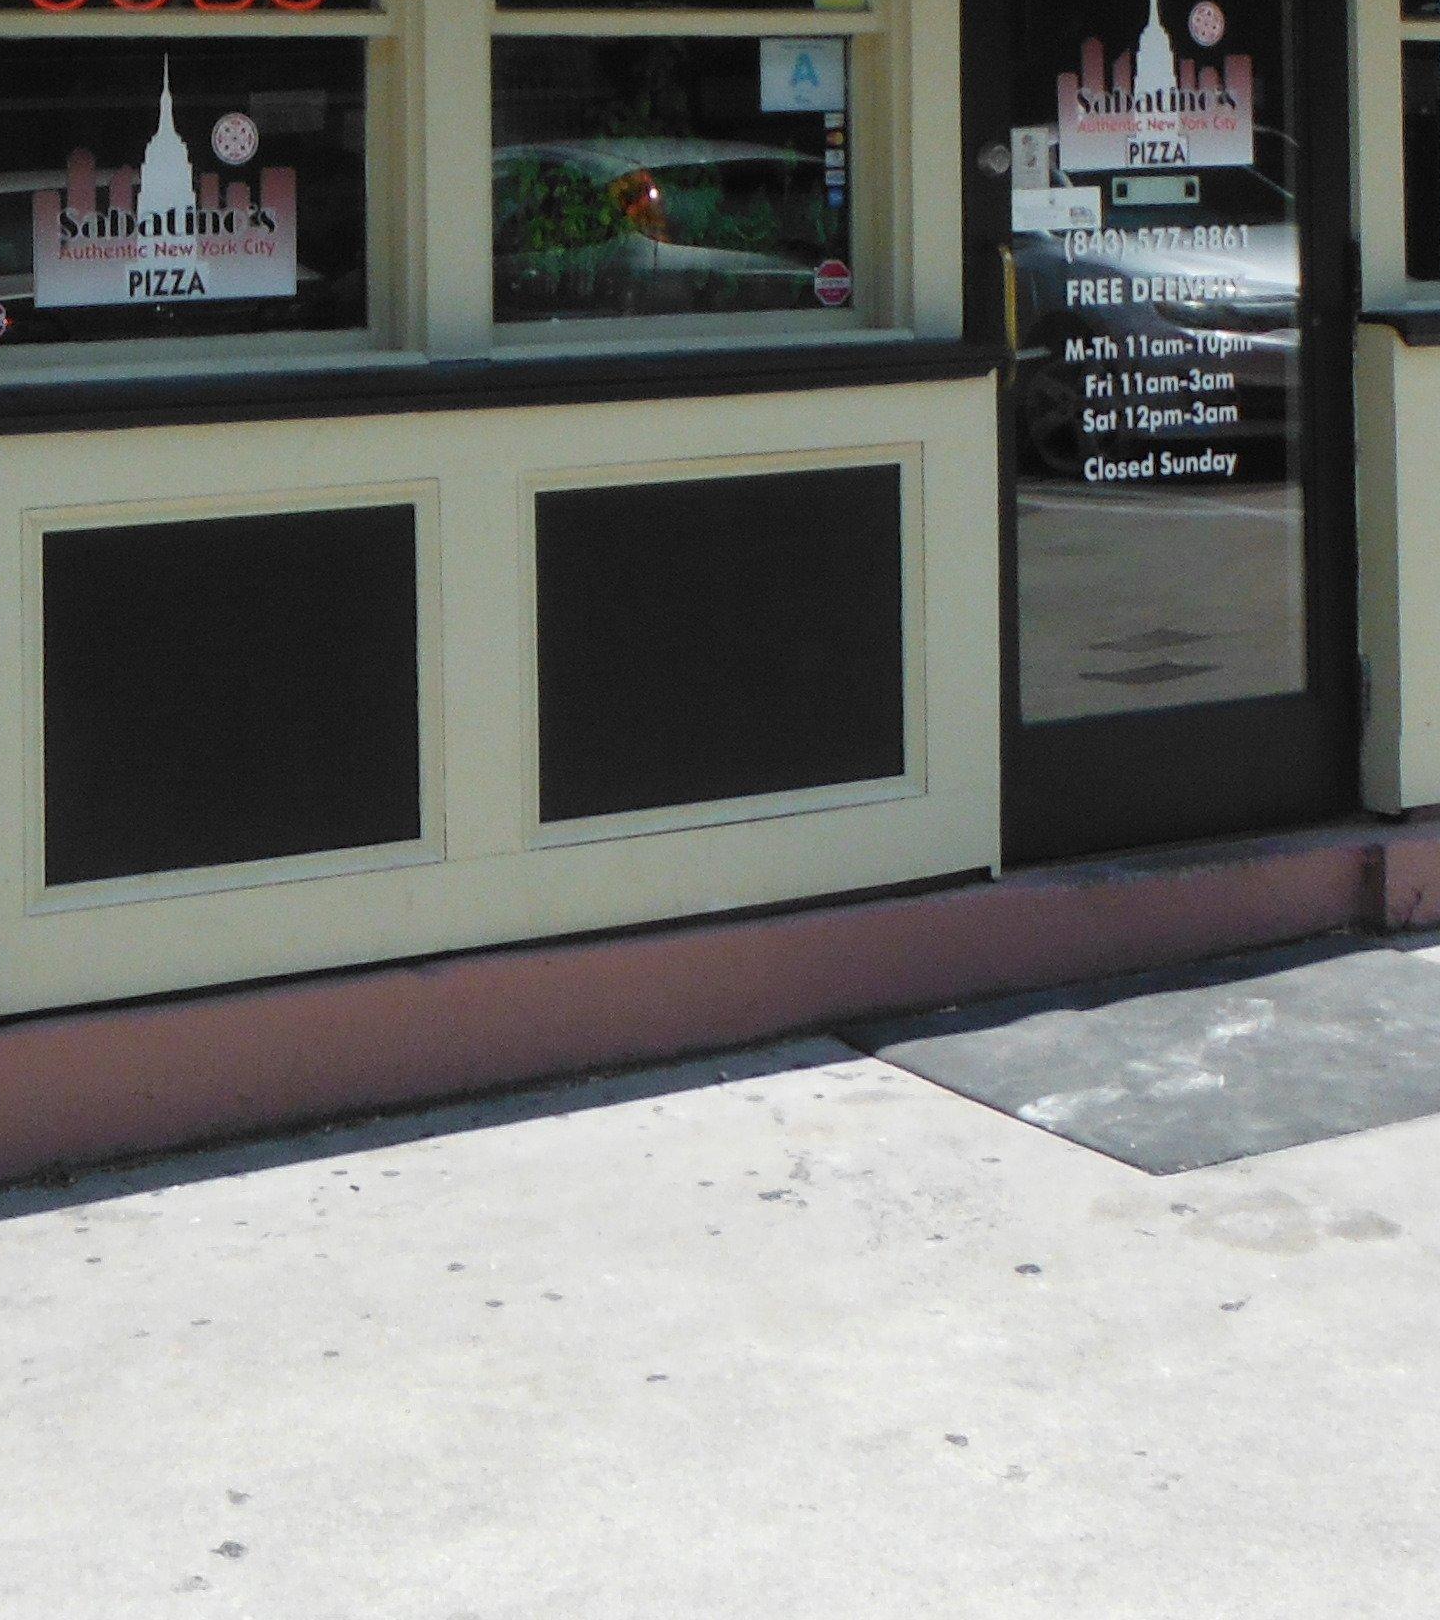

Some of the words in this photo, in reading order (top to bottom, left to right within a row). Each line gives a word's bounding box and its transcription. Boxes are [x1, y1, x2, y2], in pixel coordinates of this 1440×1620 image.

[791, 53, 820, 86] A
[1128, 140, 1186, 165] PIZZA
[59, 240, 148, 261] Authentic
[154, 240, 194, 258] New
[200, 237, 238, 258] York
[244, 237, 277, 258] City
[128, 267, 207, 299] PIZZA
[1066, 276, 1123, 307] FREE
[1065, 335, 1119, 362] M-Th
[1125, 333, 1253, 359] 11am-10pm
[1085, 371, 1113, 399] Fri
[1121, 367, 1235, 396] 11am-3am
[1082, 407, 1117, 433] Sat
[1124, 400, 1239, 433] 12pm-3am
[1084, 450, 1155, 481] Closed
[1160, 448, 1238, 476] Sunday
